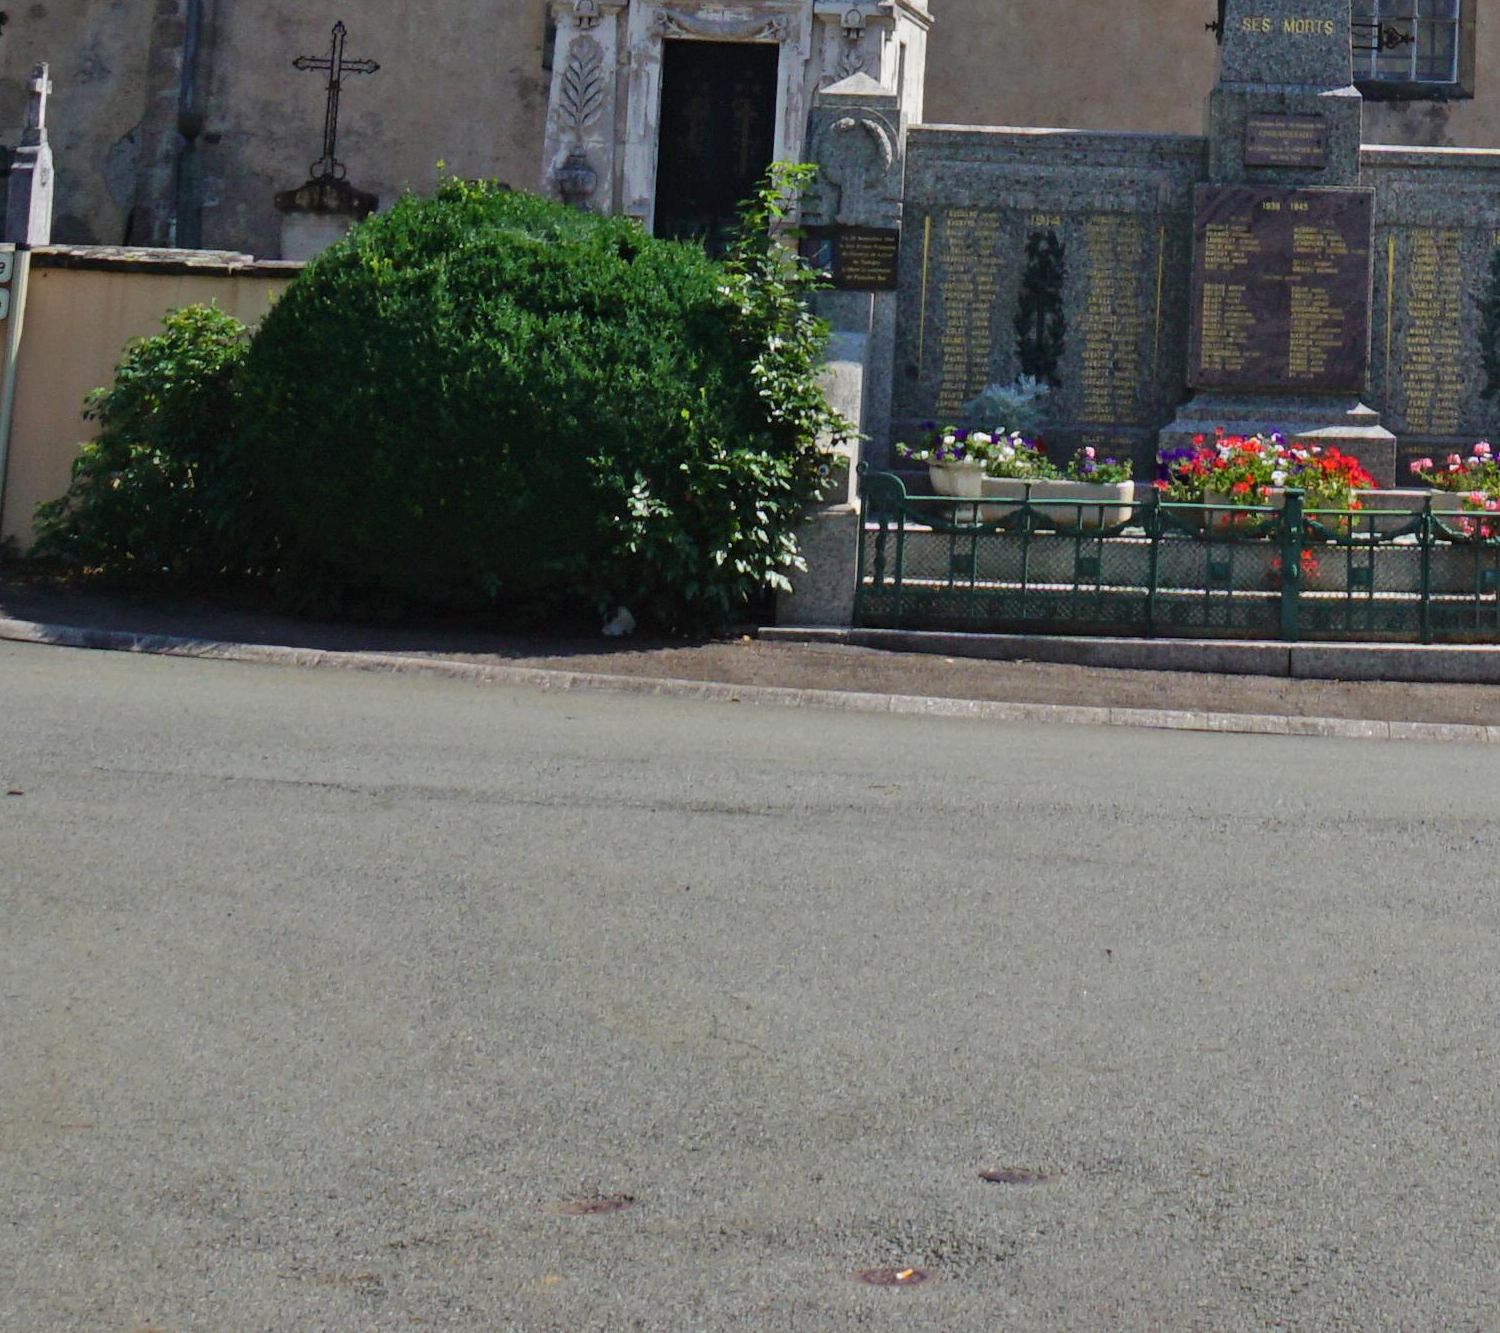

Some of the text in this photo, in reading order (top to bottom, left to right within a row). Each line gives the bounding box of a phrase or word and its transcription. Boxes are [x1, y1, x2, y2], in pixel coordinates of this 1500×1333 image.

[1242, 17, 1334, 35] SES MORTS
[1290, 201, 1309, 212] 1945
